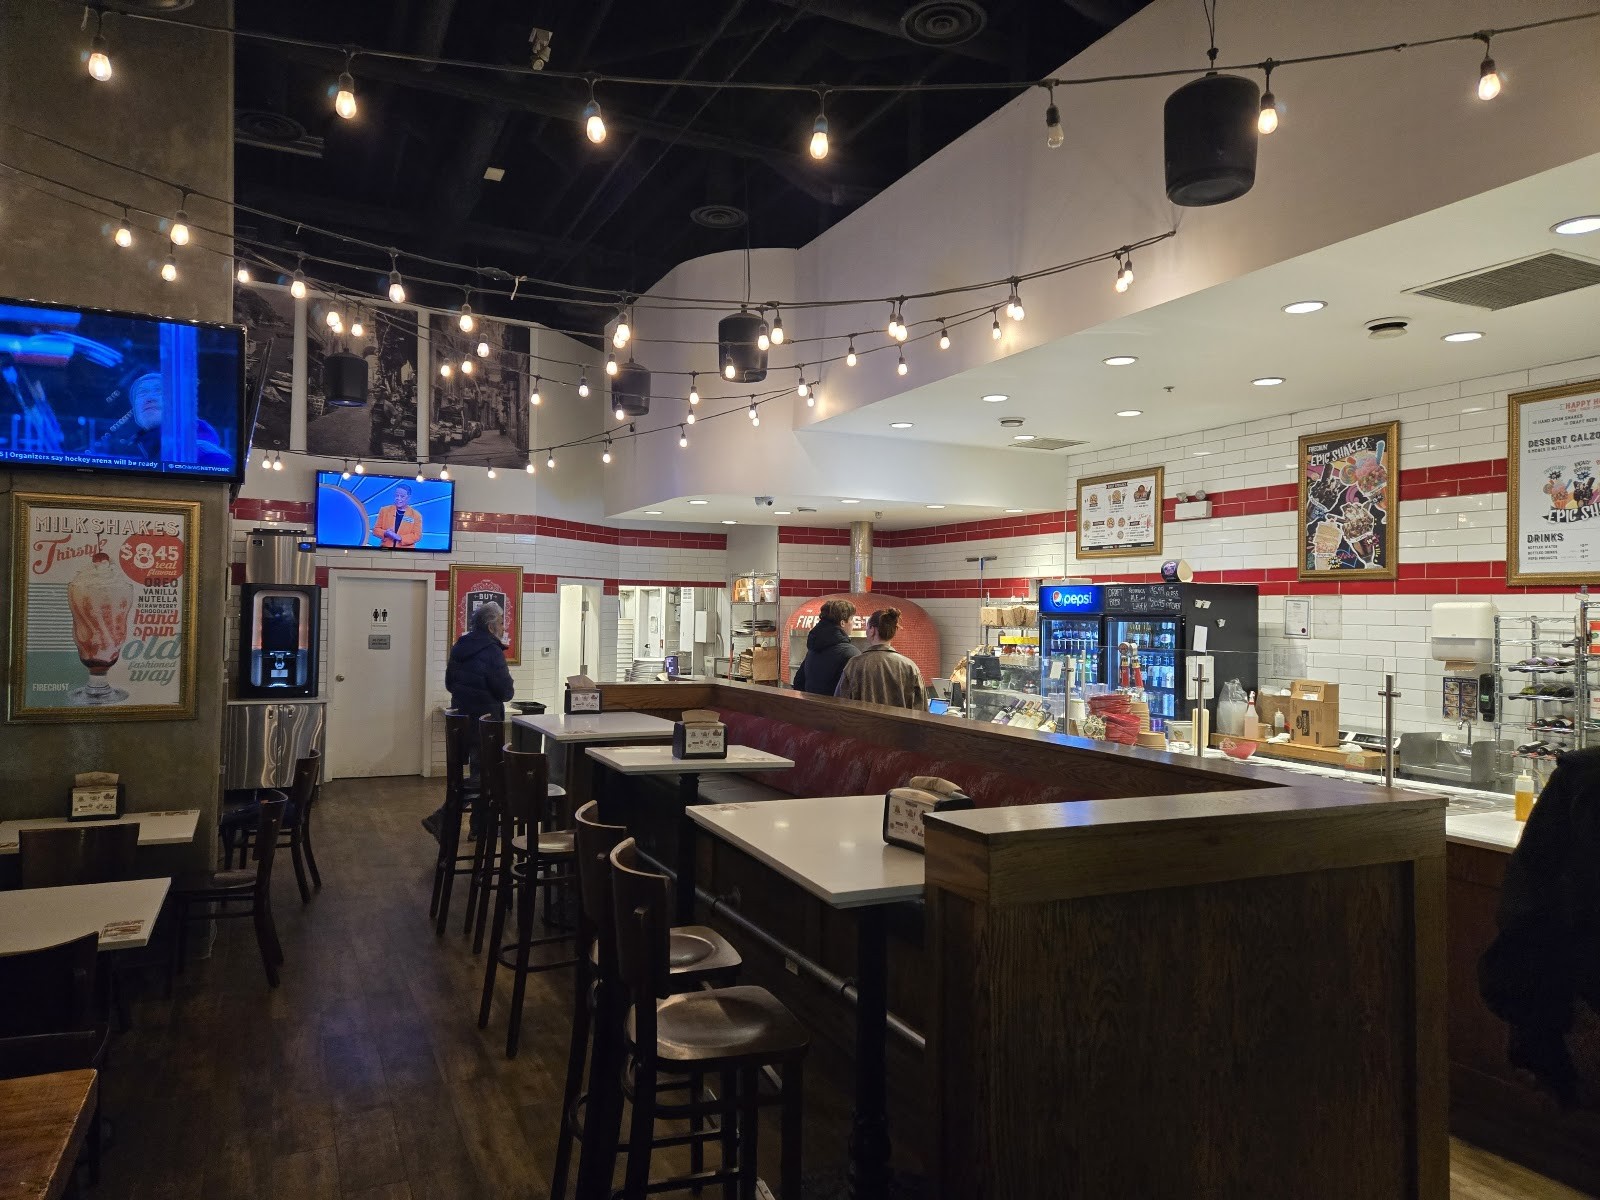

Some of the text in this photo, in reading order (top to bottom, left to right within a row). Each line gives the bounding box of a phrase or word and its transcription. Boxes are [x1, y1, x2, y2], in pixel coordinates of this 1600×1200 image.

[1566, 400, 1590, 410] HAPPY
[1528, 436, 1568, 448] DESSERT
[1311, 436, 1368, 466] EPIC SHAKES
[10, 452, 50, 460] Organizers
[65, 456, 90, 464] hockey
[1548, 502, 1600, 524] EPIC SH
[36, 516, 180, 537] MILKSHAKES
[1527, 532, 1564, 544] DRINKS
[155, 561, 176, 570] real
[147, 568, 177, 576] flavour
[144, 578, 178, 588] OREO
[144, 588, 178, 596] VANILLA
[1064, 592, 1092, 606] pepsi
[134, 608, 180, 624] hand
[132, 626, 176, 641] spun
[122, 633, 182, 660] old
[128, 660, 176, 670] fashioned
[128, 668, 176, 686] way
